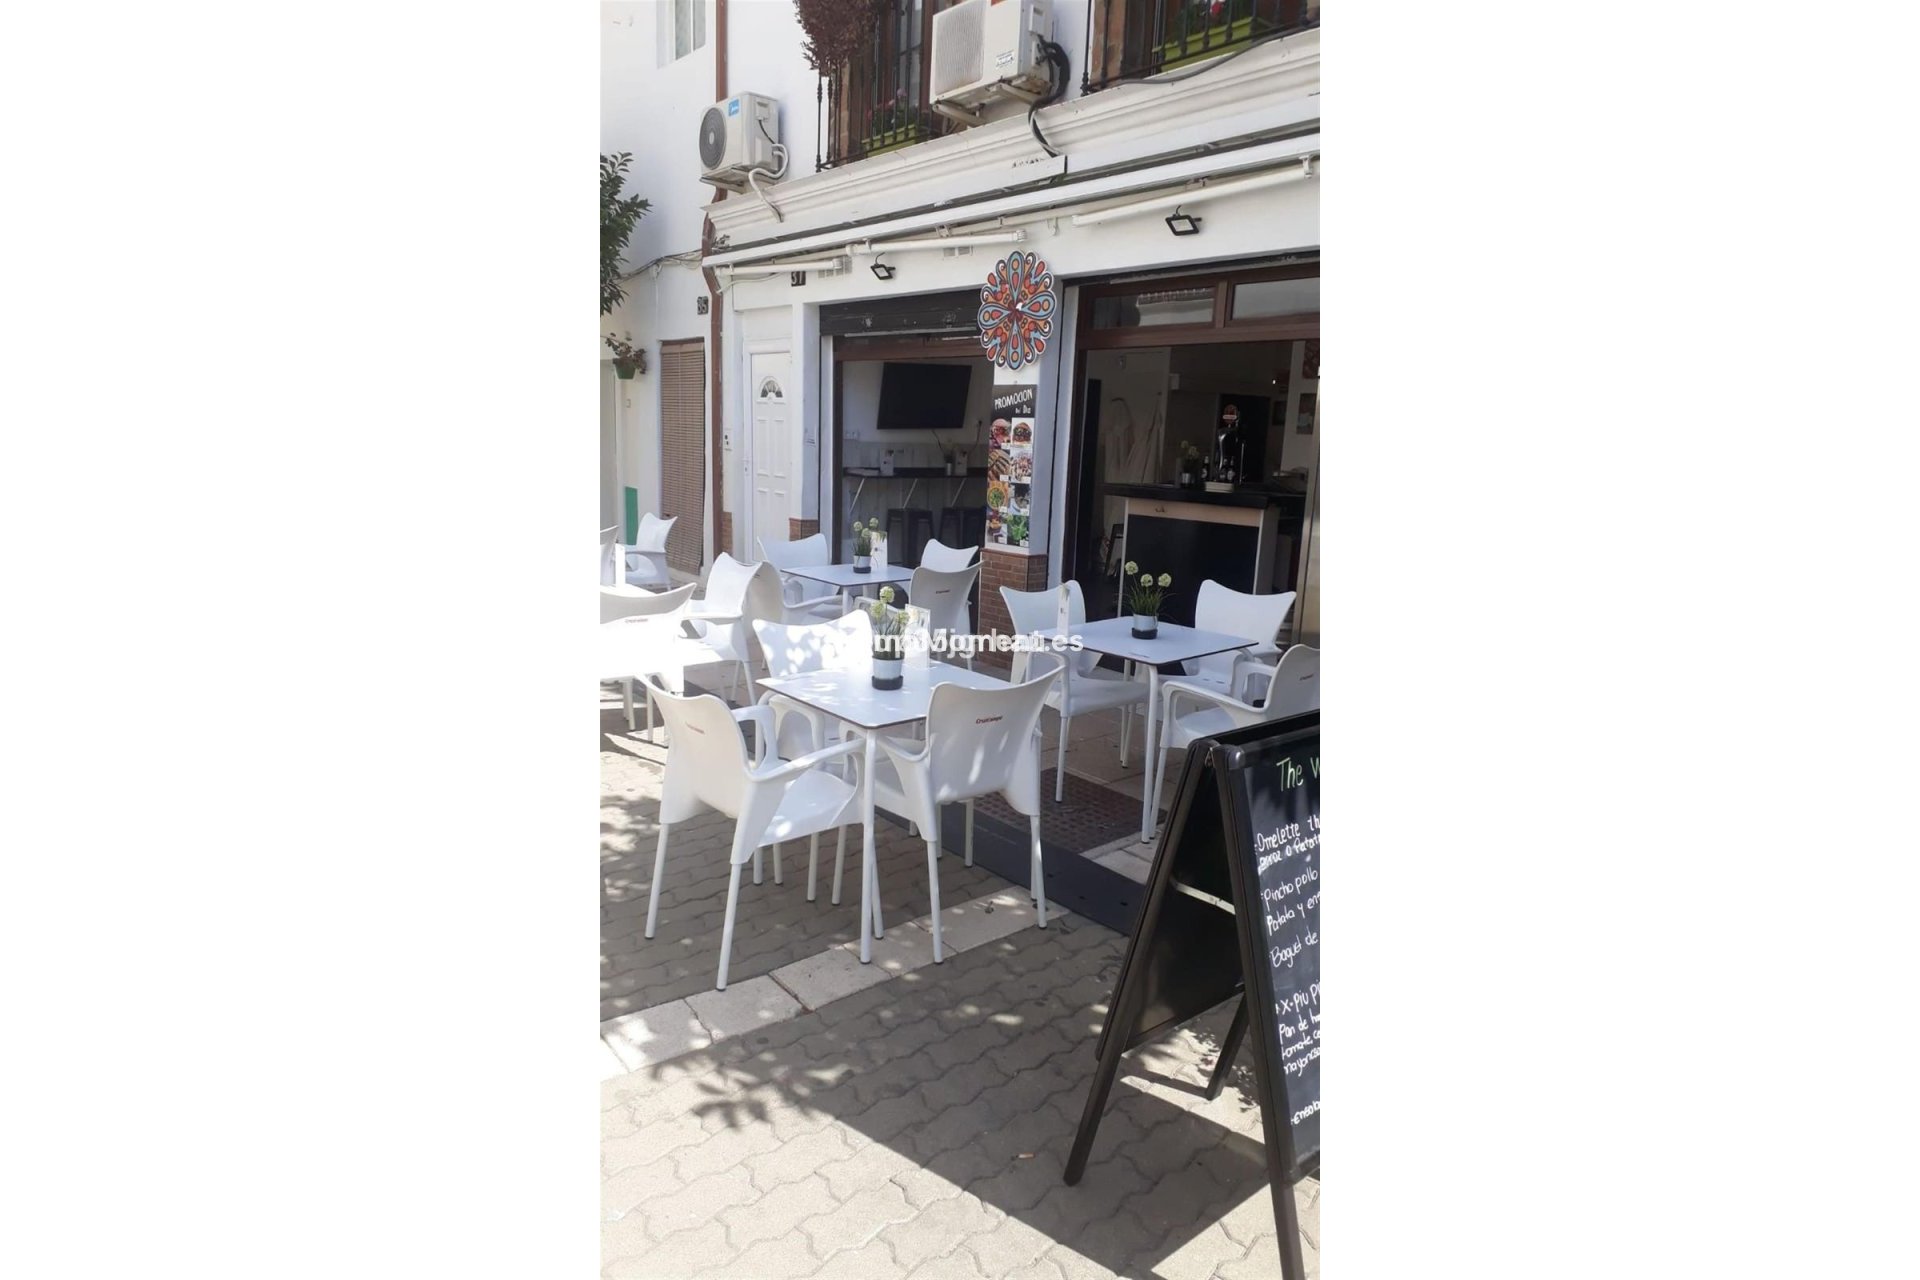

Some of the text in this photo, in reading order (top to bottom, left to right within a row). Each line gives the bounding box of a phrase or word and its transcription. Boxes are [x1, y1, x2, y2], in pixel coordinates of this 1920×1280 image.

[1276, 757, 1304, 791] The
[1304, 925, 1318, 946] de
[1298, 1014, 1308, 1031] de
